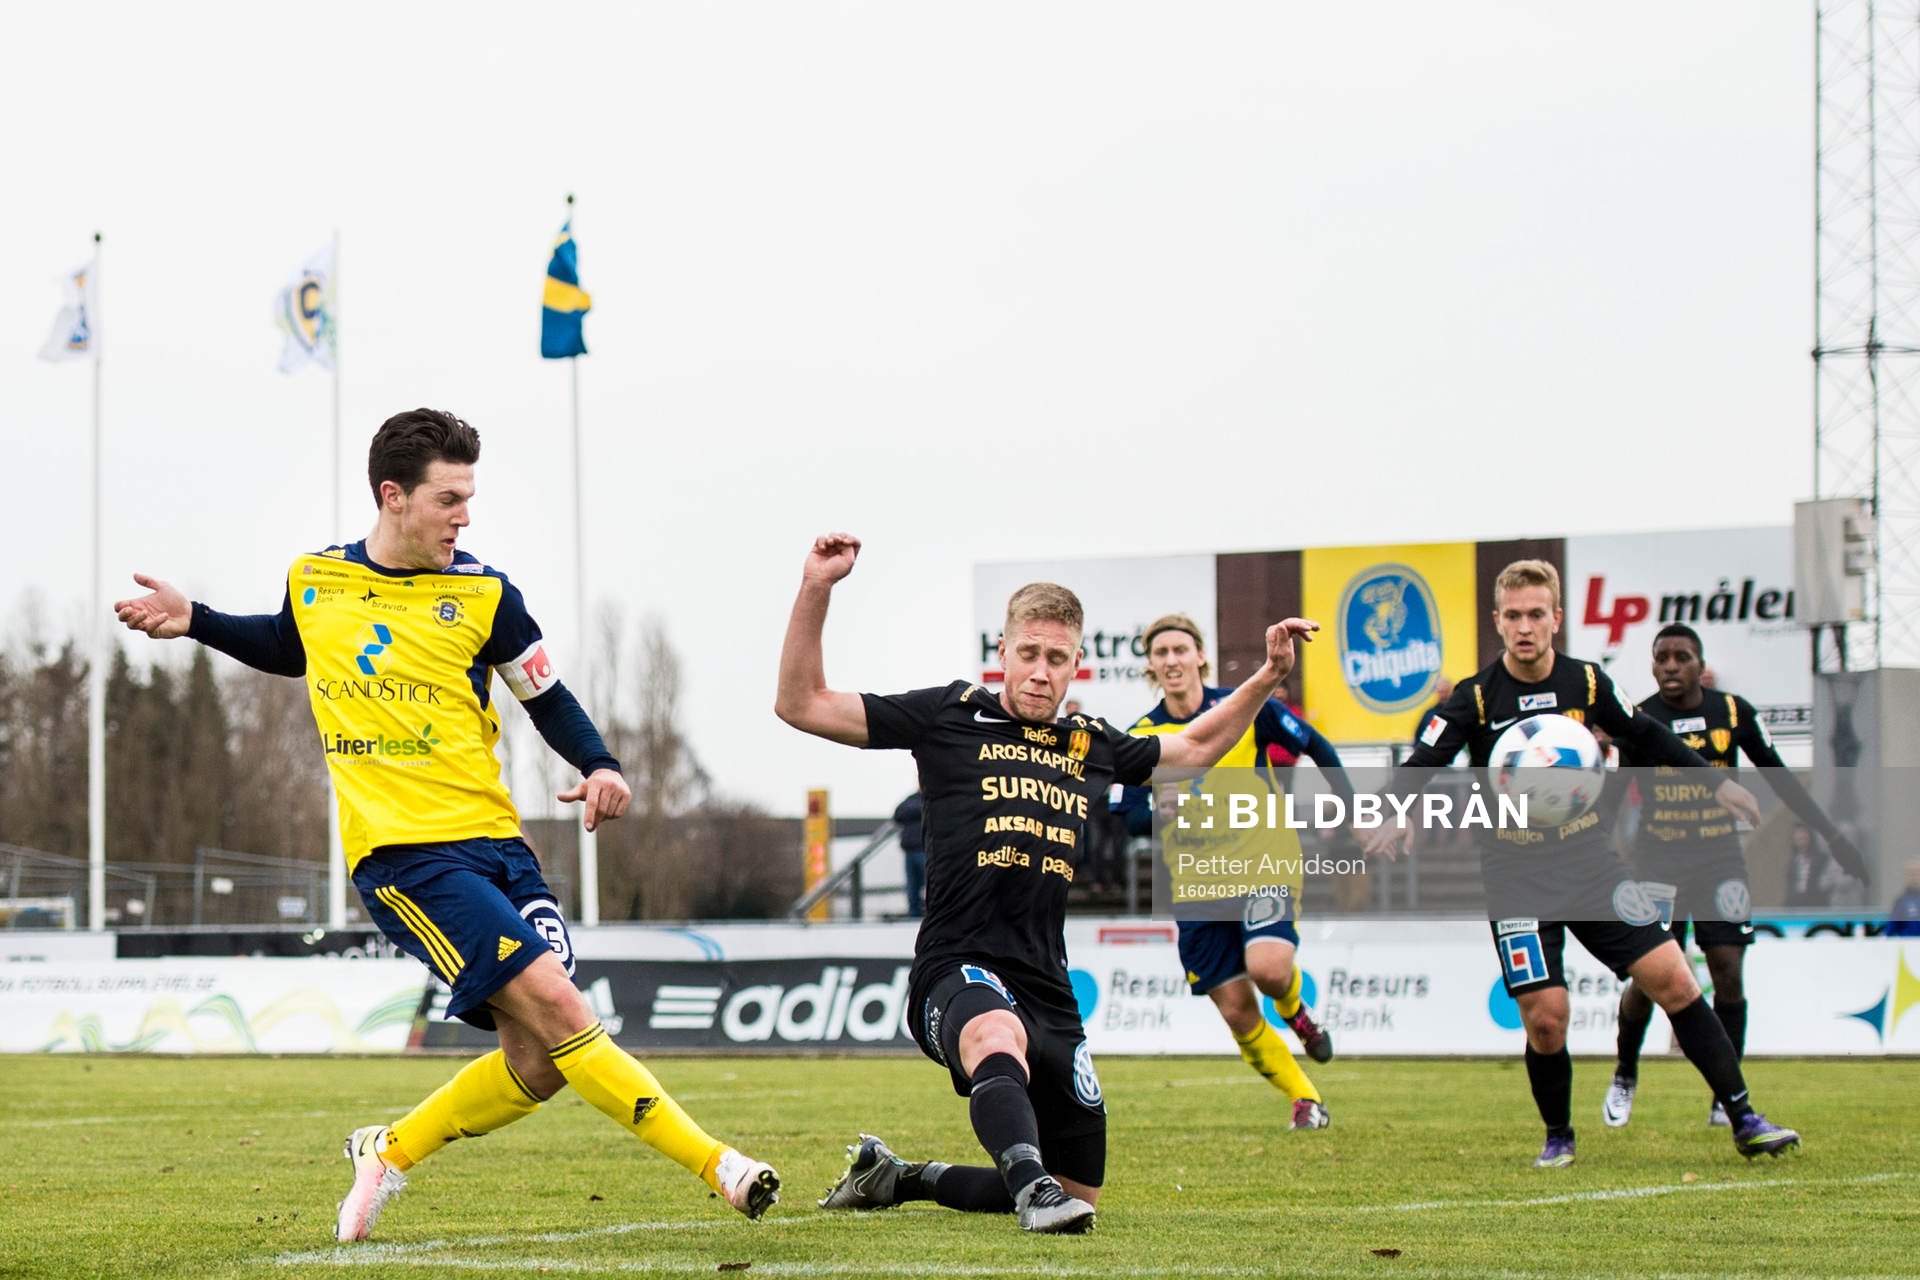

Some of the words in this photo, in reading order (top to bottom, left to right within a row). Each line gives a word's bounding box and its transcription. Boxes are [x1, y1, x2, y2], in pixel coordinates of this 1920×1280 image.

[372, 600, 408, 612] bravida
[1343, 638, 1441, 687] Chiquita
[978, 743, 1028, 761] AROS
[1030, 747, 1087, 782] KAPITAL
[981, 776, 1089, 820] SURYOYE
[984, 815, 1043, 839] AKSAB
[977, 846, 1031, 868] Basilica
[1329, 969, 1429, 997] Resurs
[1104, 1004, 1172, 1031] Bank
[1324, 1005, 1395, 1032] Bank
